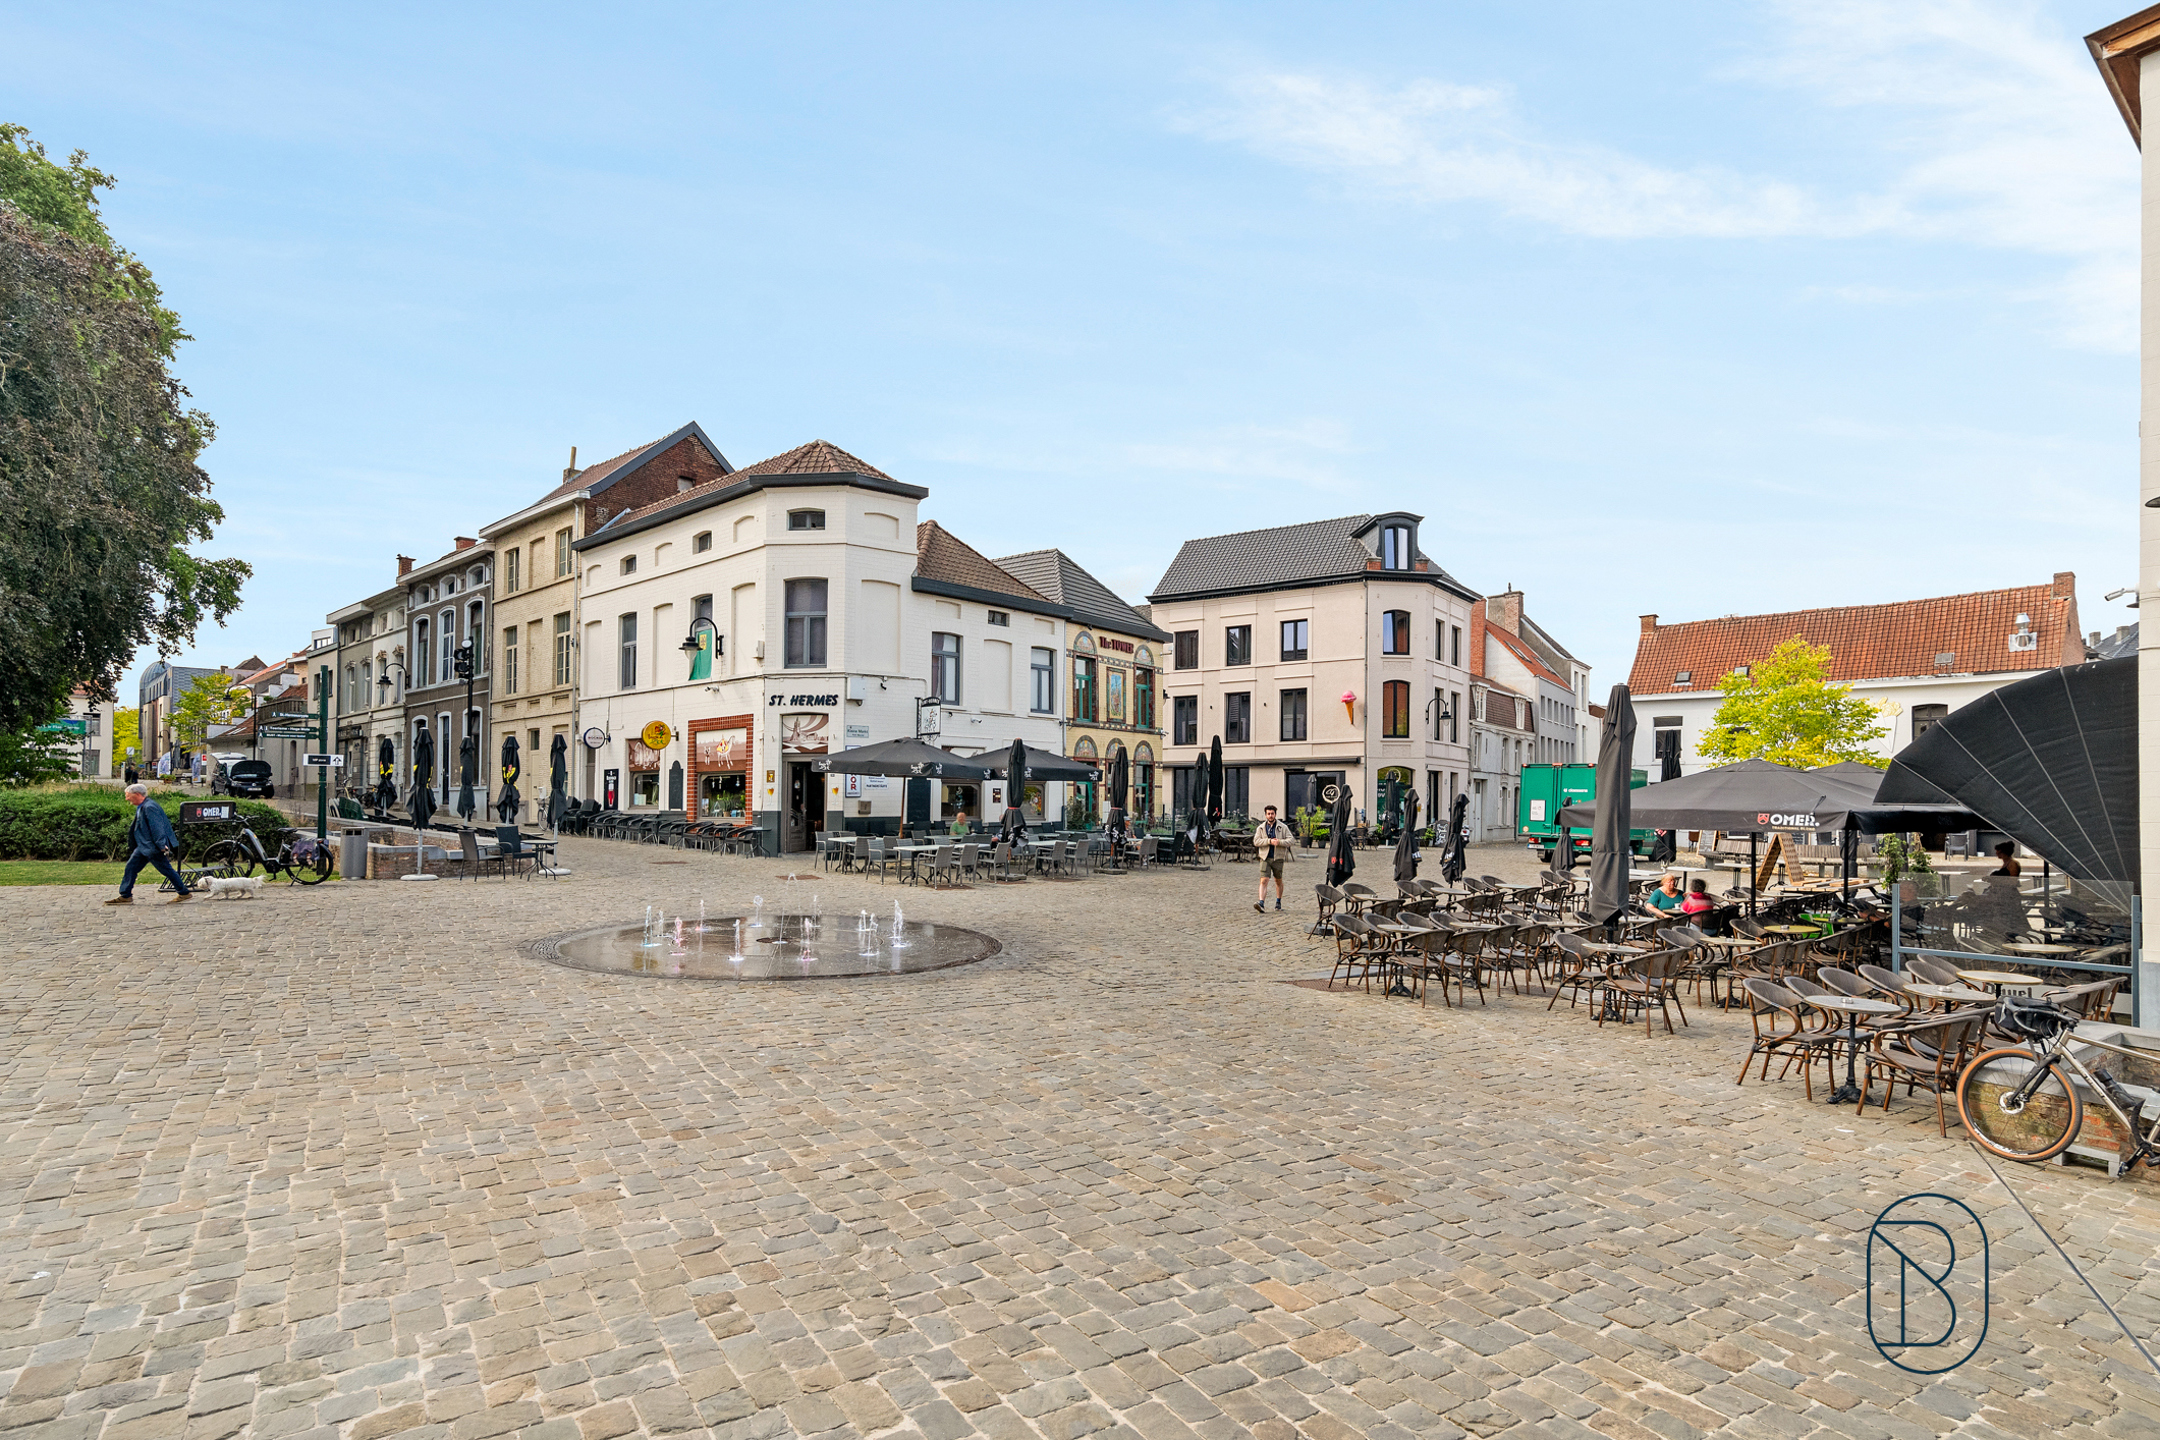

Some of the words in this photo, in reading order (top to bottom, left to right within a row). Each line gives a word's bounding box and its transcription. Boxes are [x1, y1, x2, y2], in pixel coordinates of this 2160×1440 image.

[1099, 636, 1112, 649] The
[1111, 639, 1134, 654] TOWER
[768, 694, 786, 706] ST.
[790, 694, 839, 707] HERMES
[1770, 813, 1820, 827] OMER.
